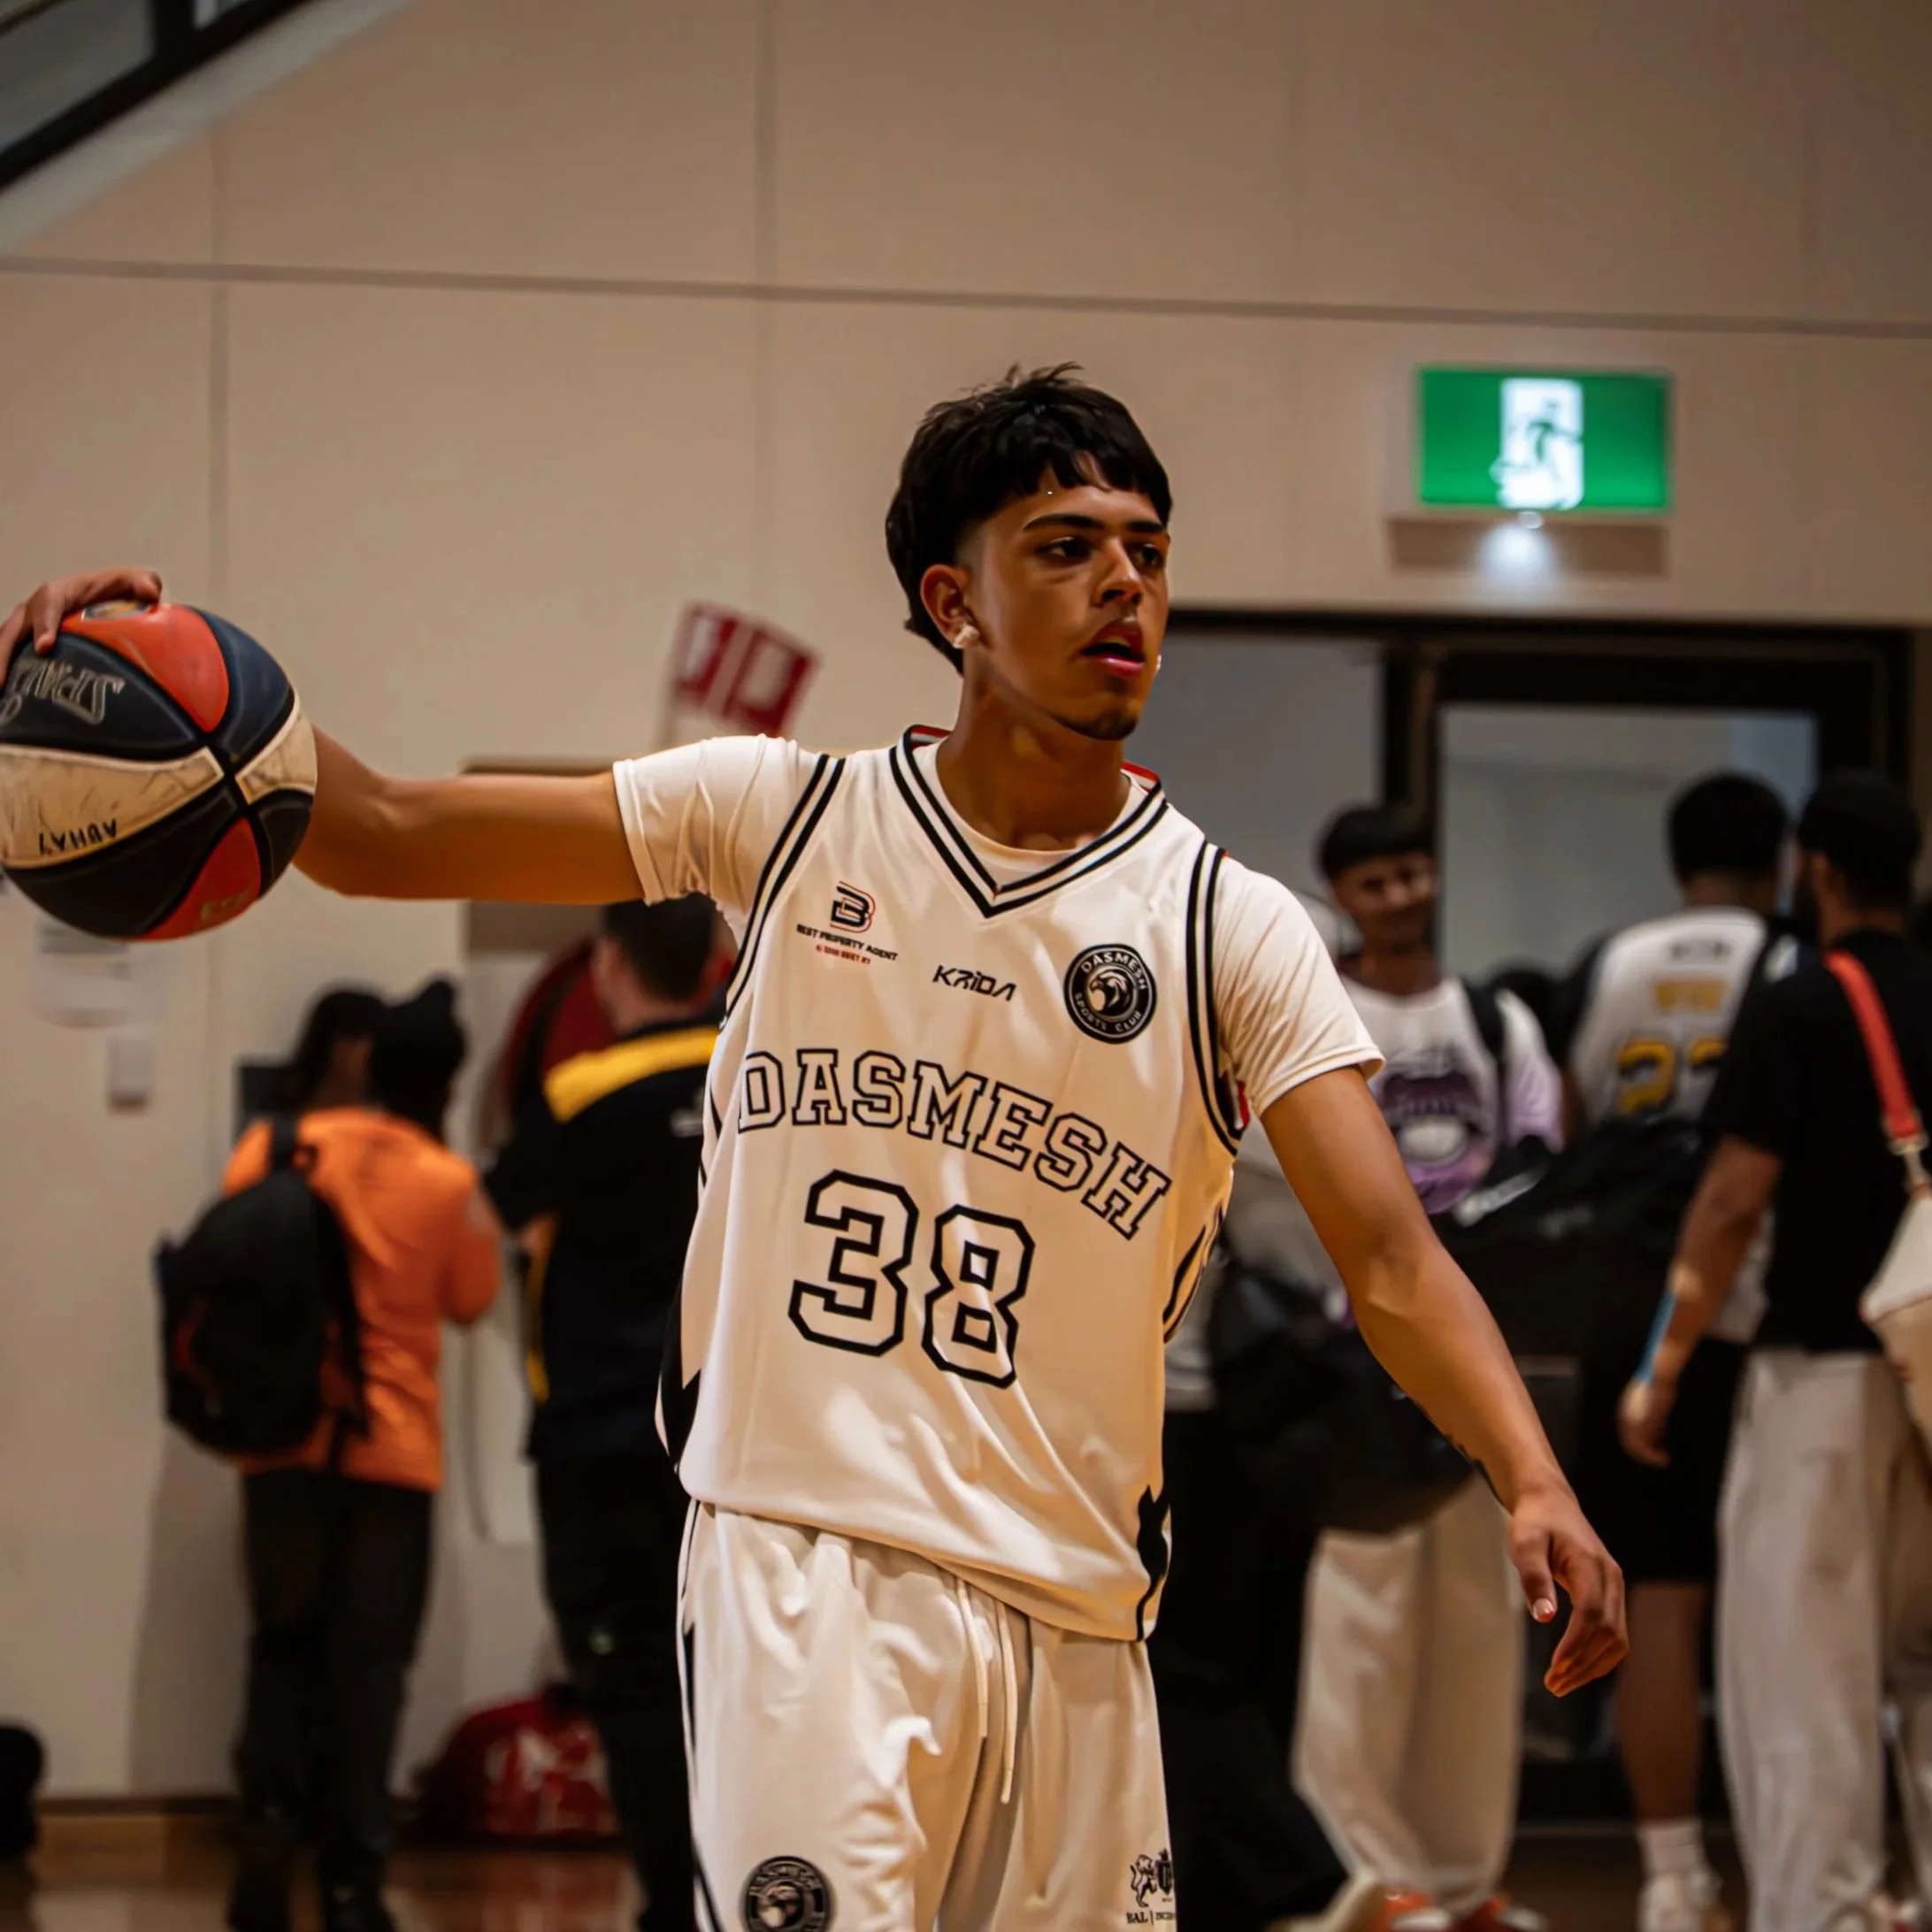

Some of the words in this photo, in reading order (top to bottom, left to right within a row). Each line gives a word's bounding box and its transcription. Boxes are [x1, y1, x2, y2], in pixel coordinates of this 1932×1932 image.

[865, 944, 898, 961] AGENT
[1080, 951, 1147, 990] DASMESH
[737, 1048, 1171, 1240] DASMESH
[787, 1169, 1036, 1390] 38
